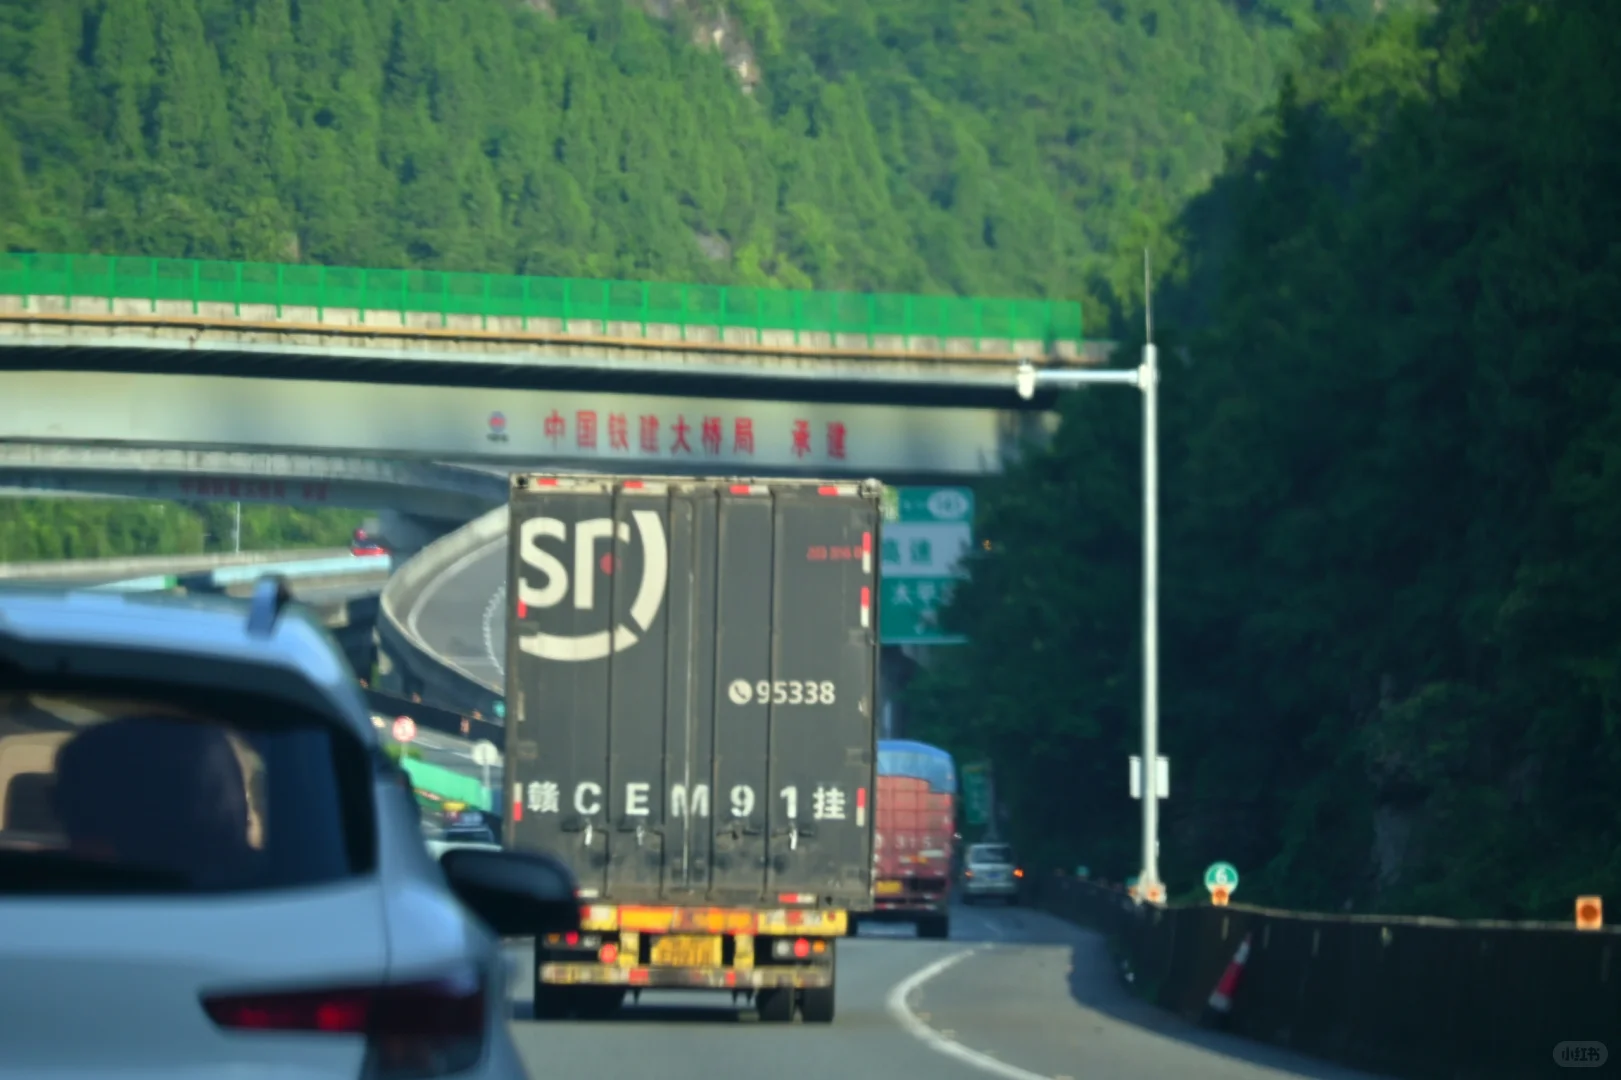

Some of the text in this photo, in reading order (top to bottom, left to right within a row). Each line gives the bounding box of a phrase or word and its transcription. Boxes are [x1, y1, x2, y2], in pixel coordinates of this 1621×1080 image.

[543, 409, 846, 460] 中国铁建大桥局 承建
[756, 680, 836, 705] 95338
